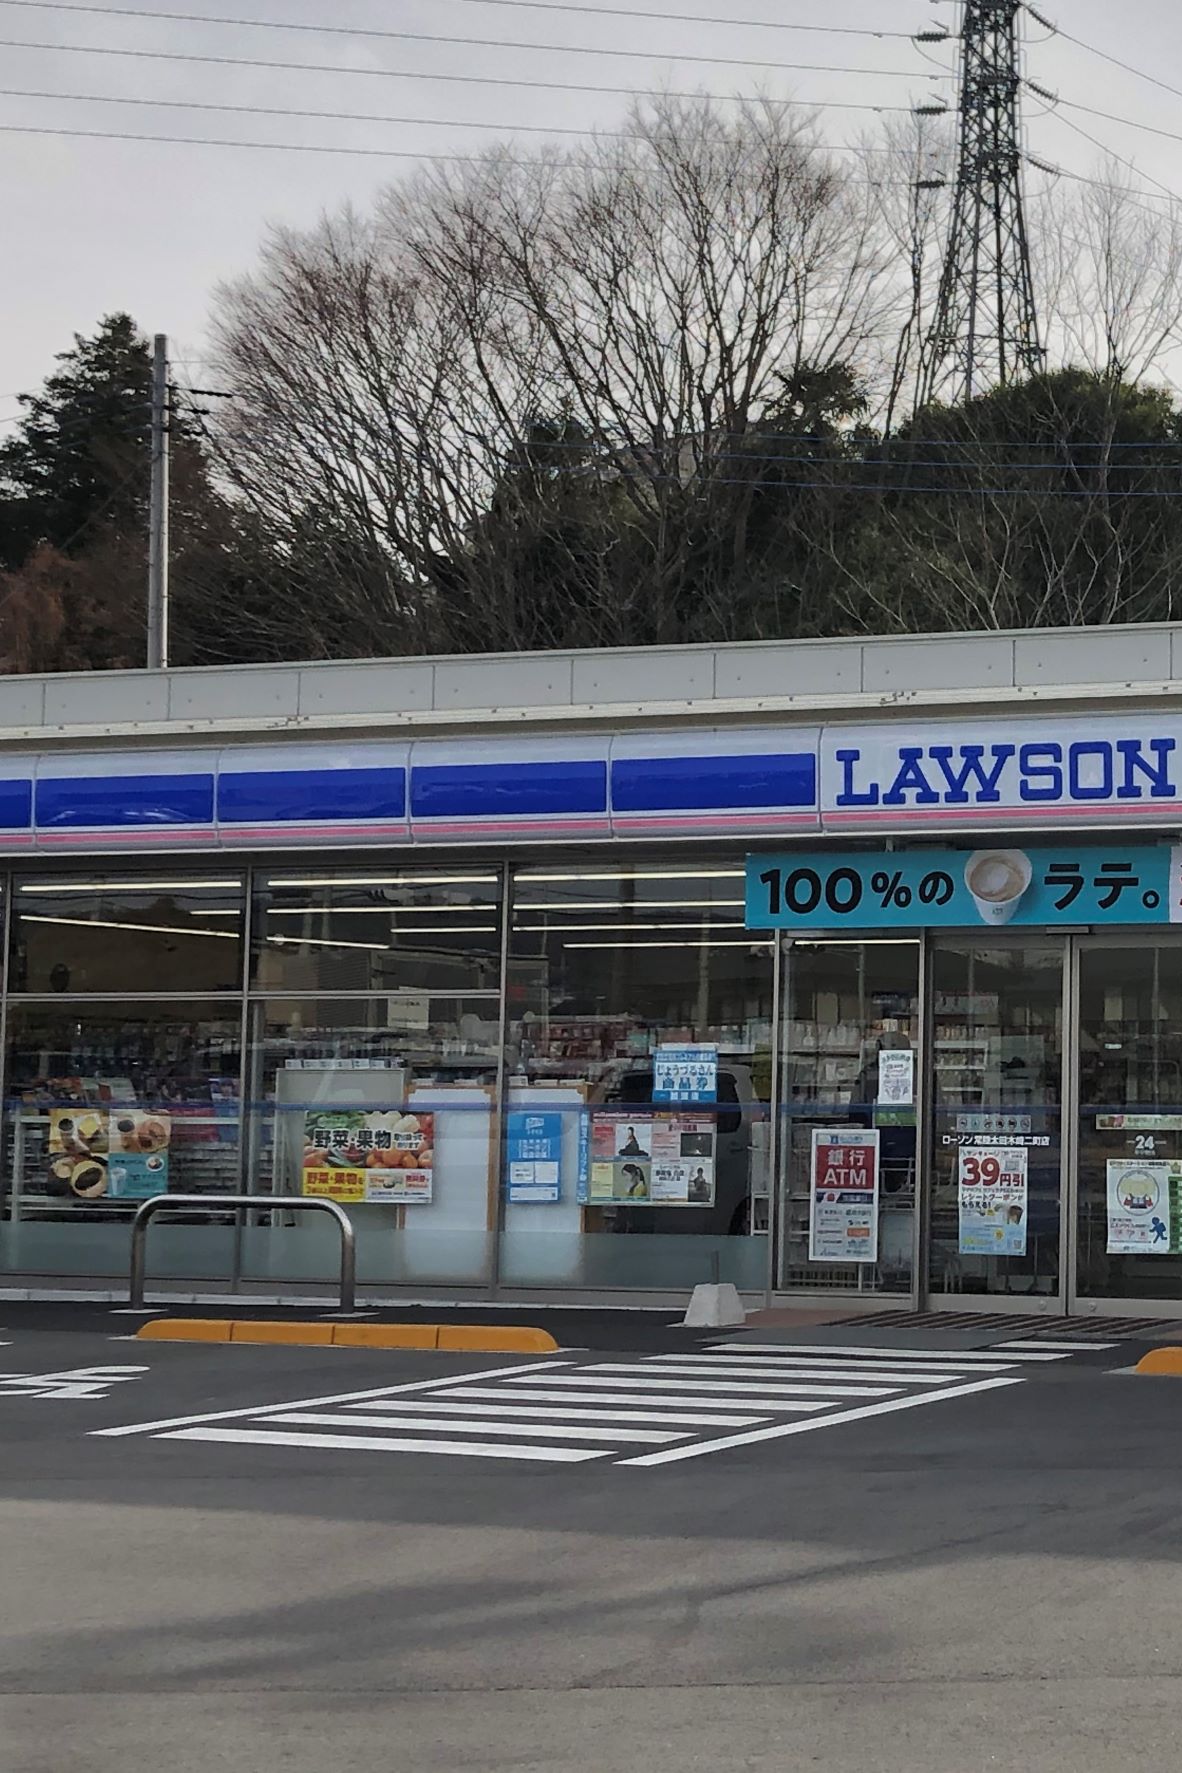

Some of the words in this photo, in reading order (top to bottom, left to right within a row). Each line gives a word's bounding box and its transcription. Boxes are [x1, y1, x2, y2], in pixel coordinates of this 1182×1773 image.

[836, 738, 1176, 806] LAWSON
[1135, 1135, 1155, 1149] 24
[827, 1149, 866, 1166] 銀行
[823, 1168, 867, 1185] ATM
